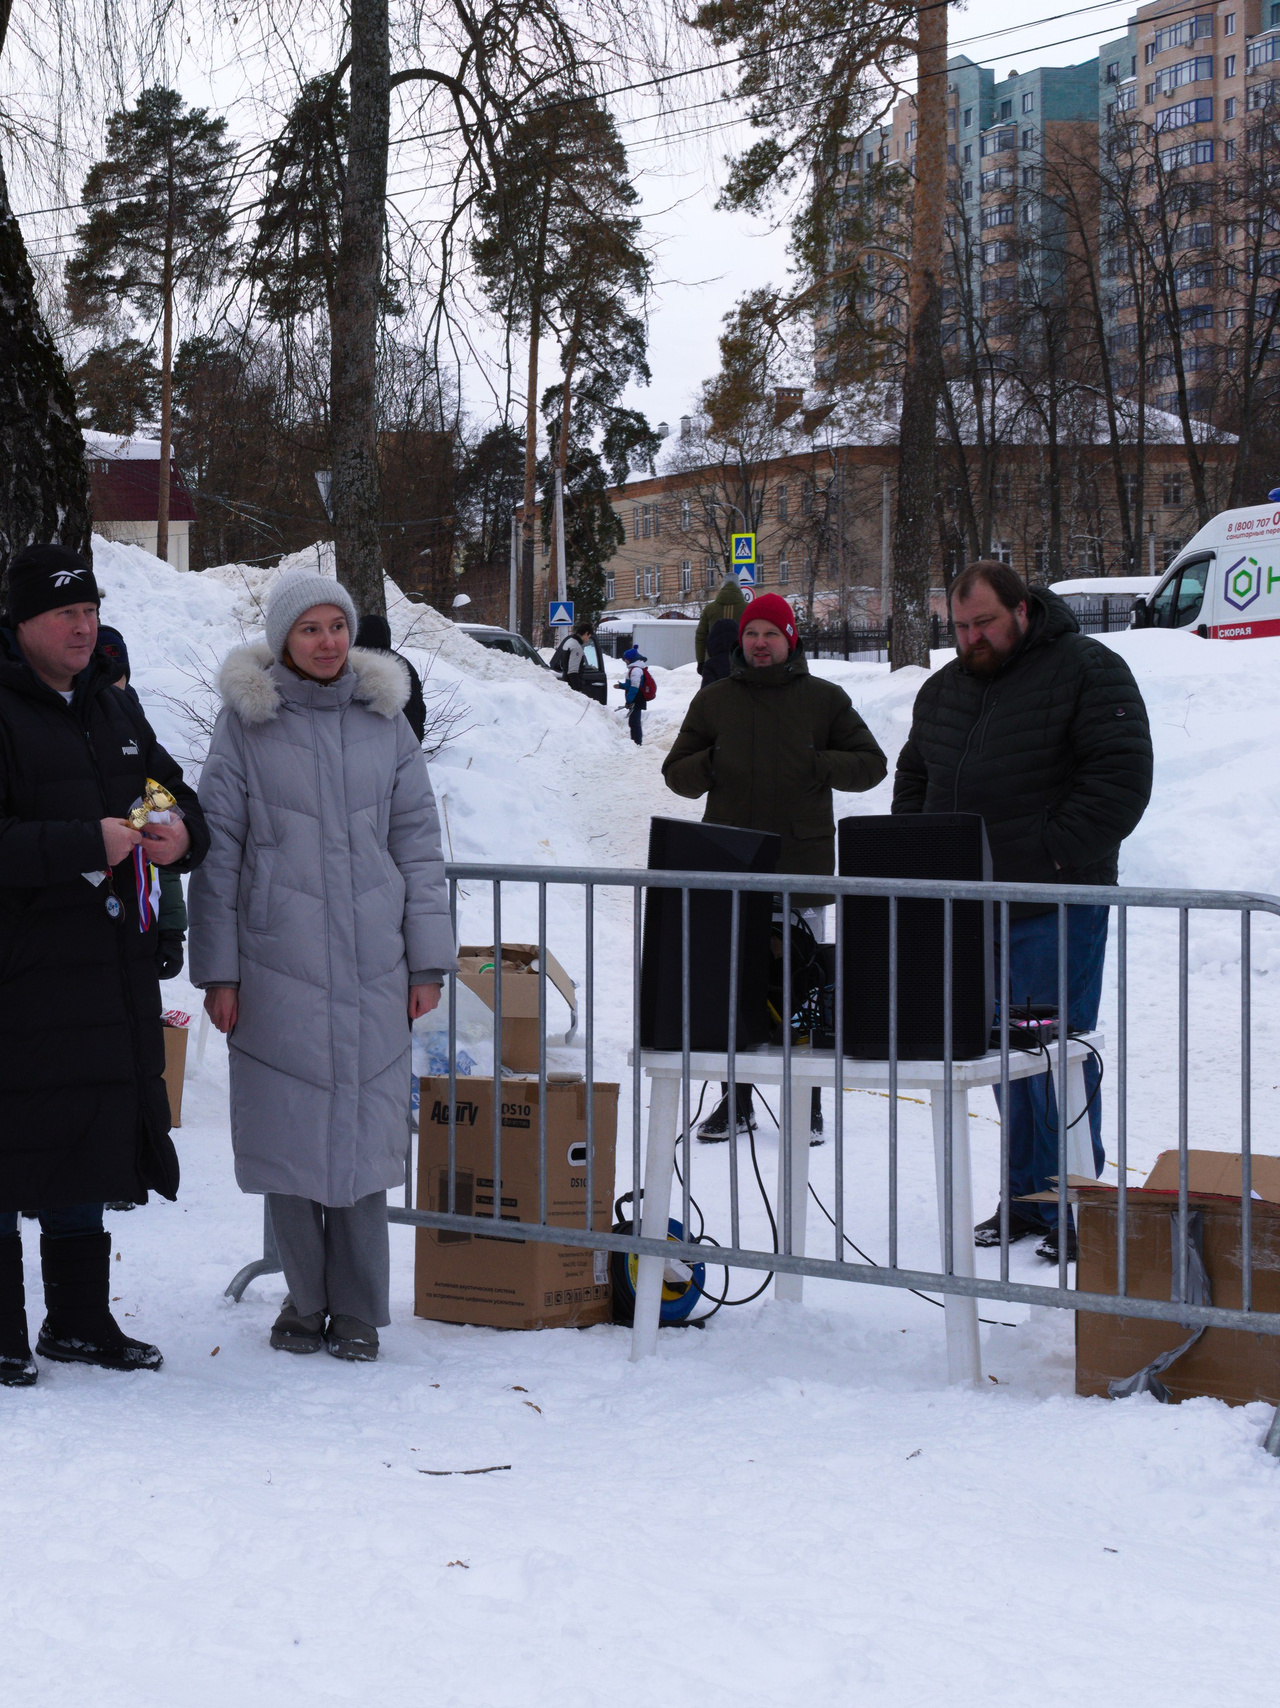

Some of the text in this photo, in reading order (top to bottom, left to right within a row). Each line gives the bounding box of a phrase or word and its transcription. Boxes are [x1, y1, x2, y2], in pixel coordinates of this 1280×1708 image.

[1227, 523, 1233, 532] 8
[1234, 520, 1254, 532] (800)
[1256, 517, 1271, 528] 707
[1219, 626, 1252, 638] СКОРАЯ
[501, 1103, 531, 1116] DS10
